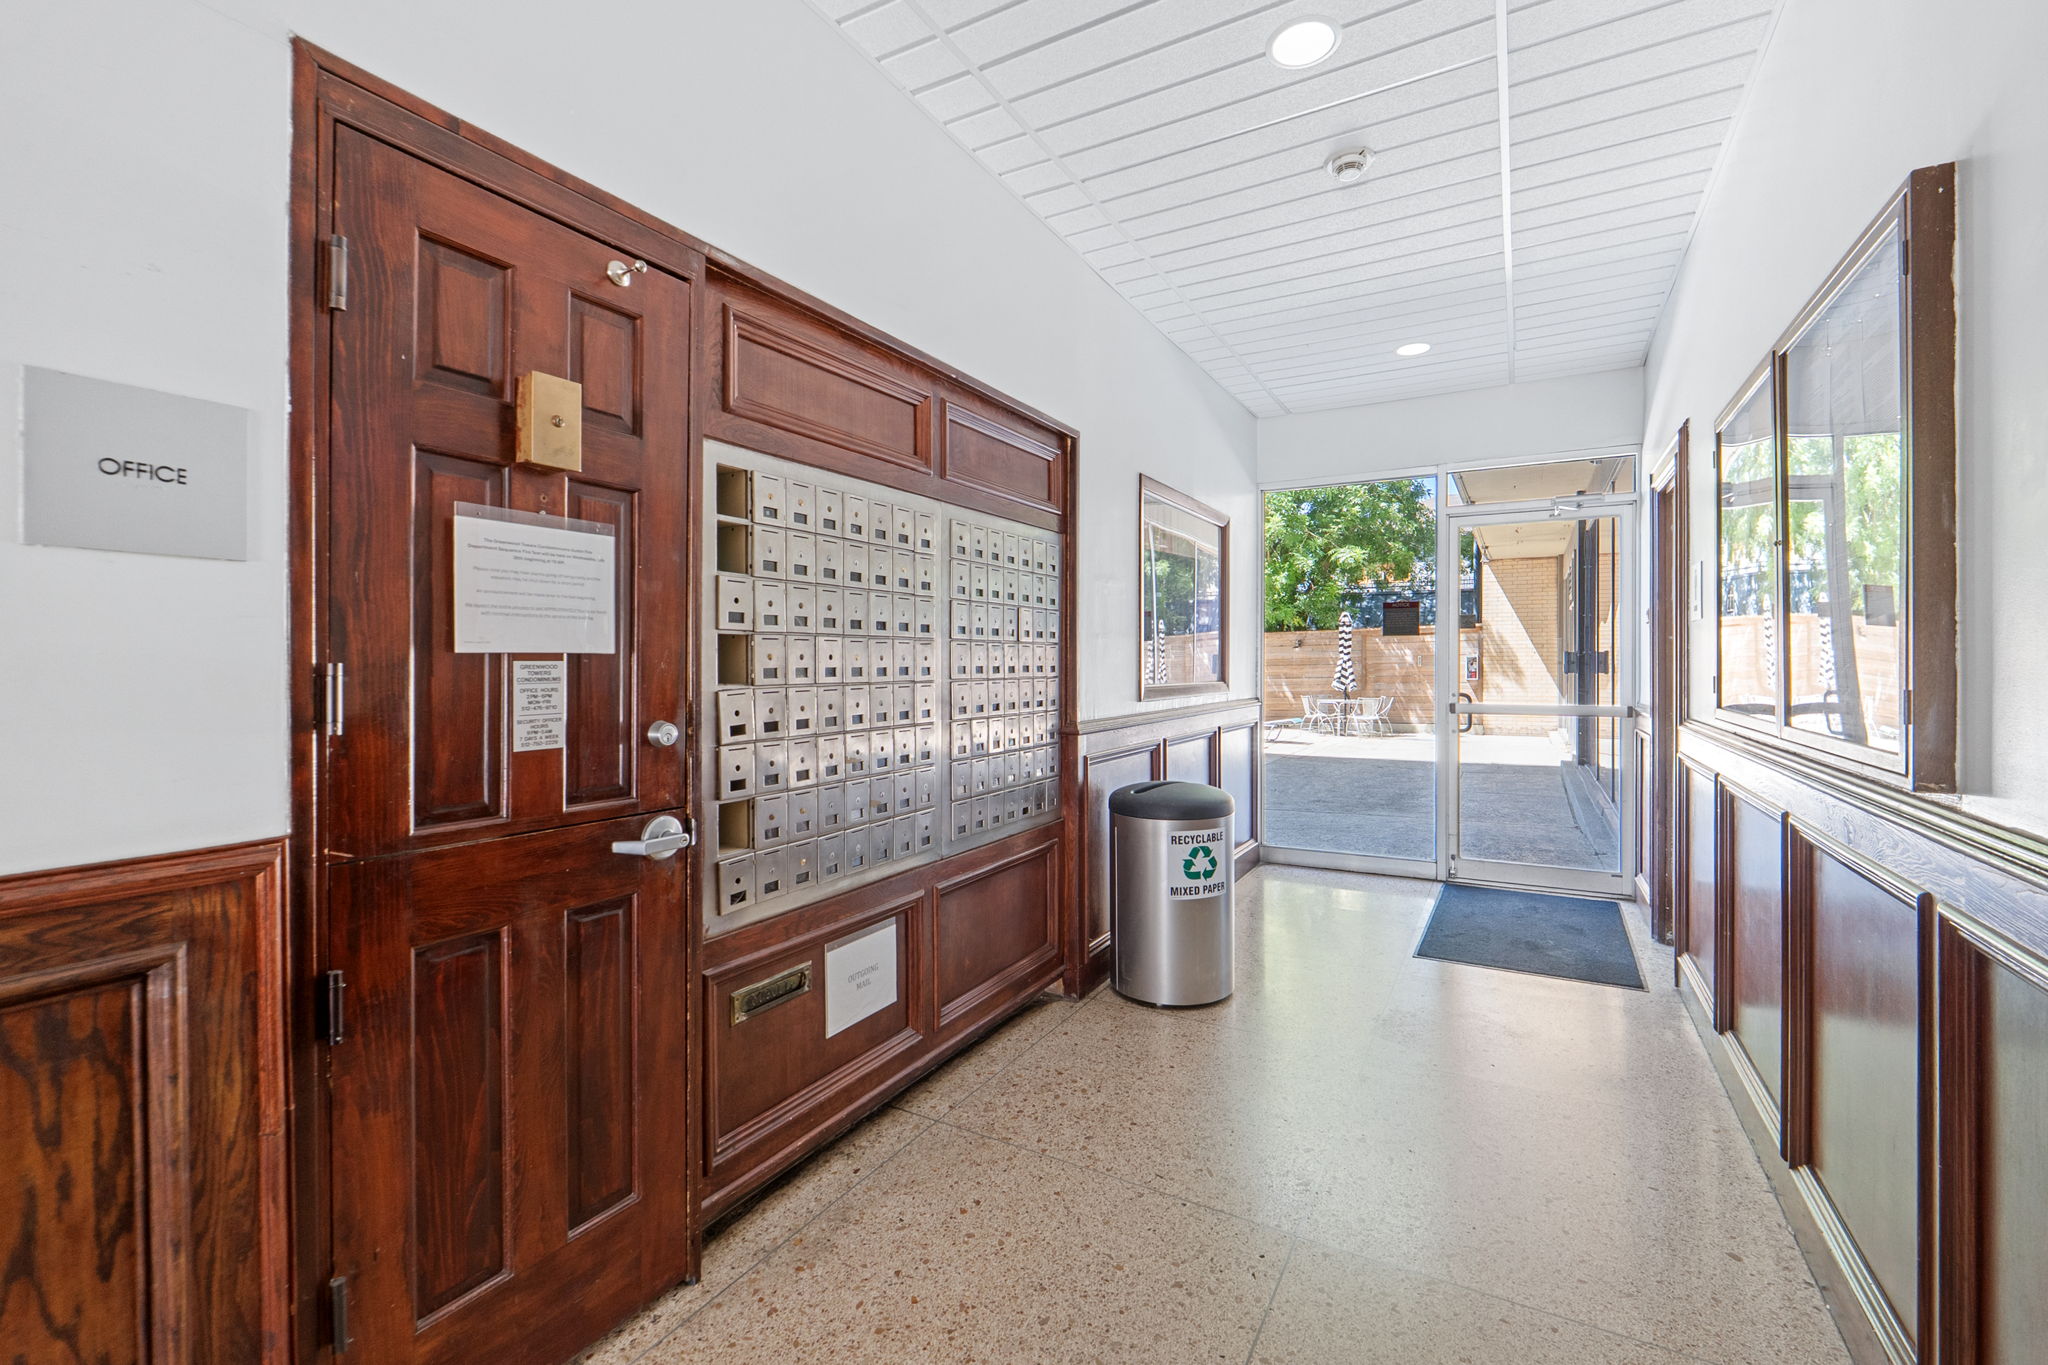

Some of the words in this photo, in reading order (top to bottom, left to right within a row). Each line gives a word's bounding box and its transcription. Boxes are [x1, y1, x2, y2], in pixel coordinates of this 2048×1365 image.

[98, 457, 188, 485] OFFICE
[1171, 832, 1223, 845] RECYCLABLE
[1170, 886, 1201, 897] MIXED
[1202, 882, 1224, 895] PAPER
[847, 962, 879, 984] OUTGOING
[856, 977, 872, 991] MAIL
